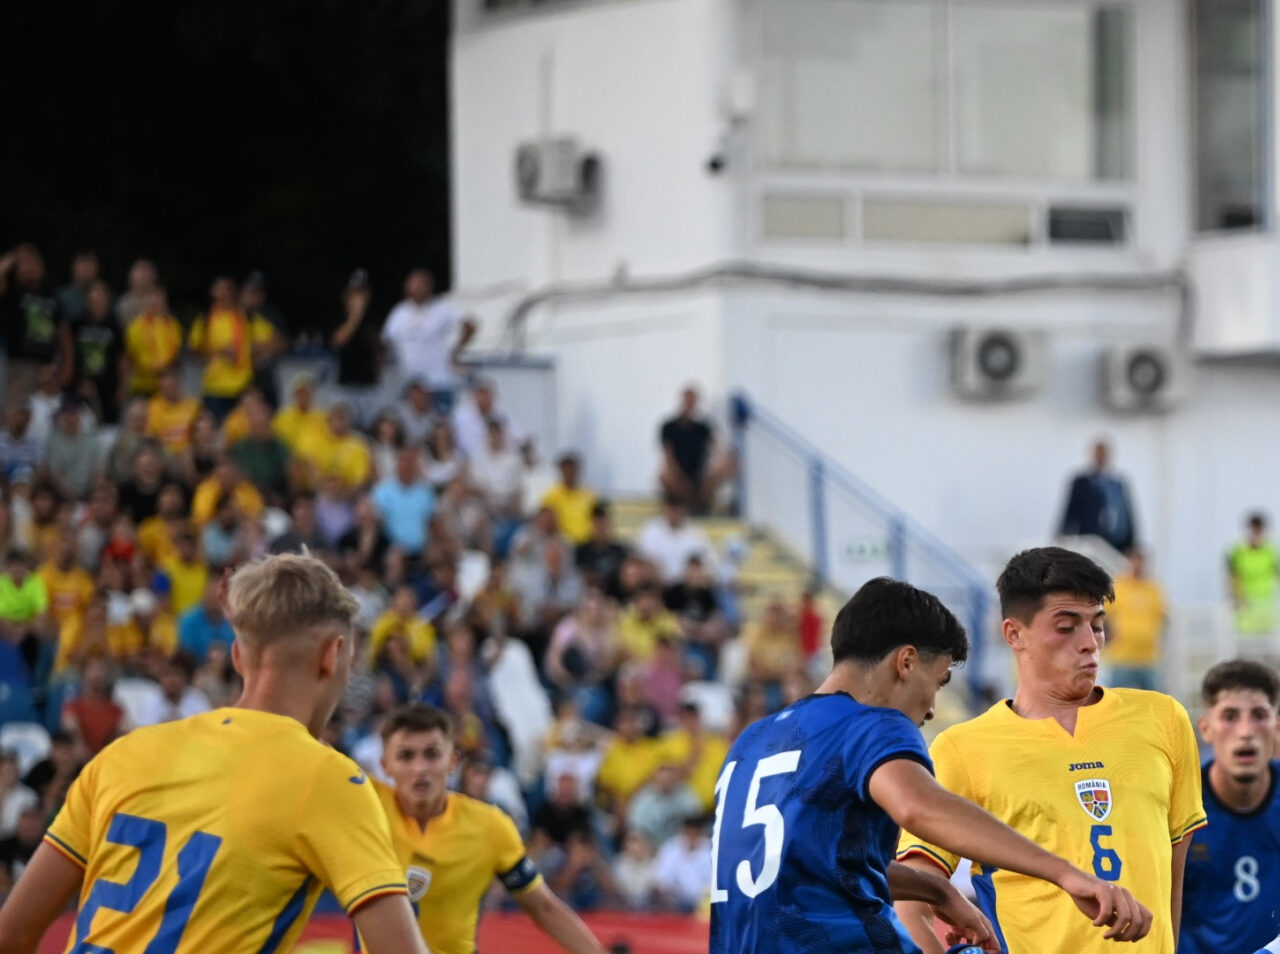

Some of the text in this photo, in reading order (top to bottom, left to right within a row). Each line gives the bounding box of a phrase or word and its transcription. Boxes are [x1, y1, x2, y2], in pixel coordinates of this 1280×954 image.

[710, 749, 802, 903] 15
[1089, 824, 1123, 882] 6
[1233, 855, 1261, 903] 8
